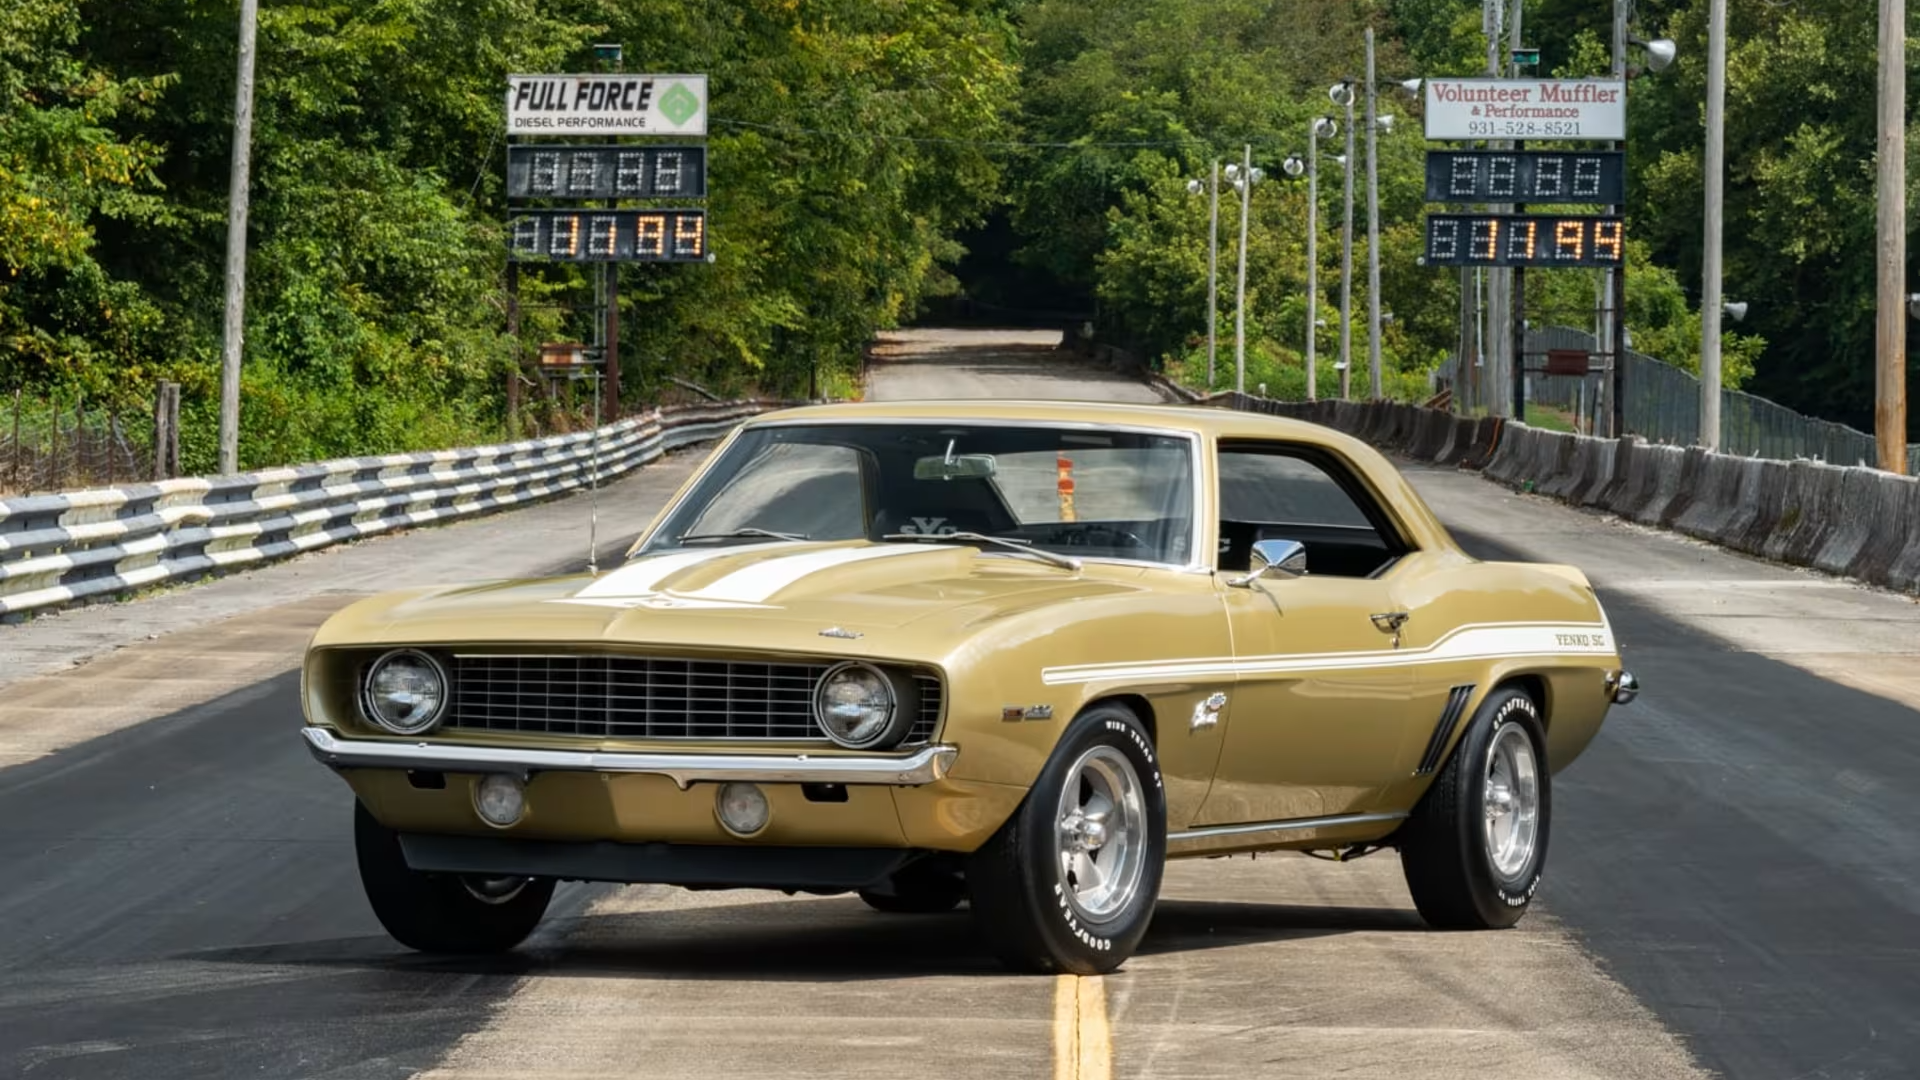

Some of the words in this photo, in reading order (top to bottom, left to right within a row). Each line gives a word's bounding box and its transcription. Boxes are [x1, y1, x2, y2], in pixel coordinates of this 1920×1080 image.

[514, 81, 568, 111] FULL
[573, 81, 653, 111] FORCE
[1432, 83, 1531, 103] Volunteer
[1539, 83, 1619, 104] Muffler
[1471, 107, 1481, 116] &
[1484, 104, 1580, 118] Performance
[515, 117, 554, 128] DIESEL
[557, 117, 646, 128] PERFORMANCE
[1468, 121, 1581, 135] 931-528-8521
[1054, 883, 1111, 951] GOODYEAR
